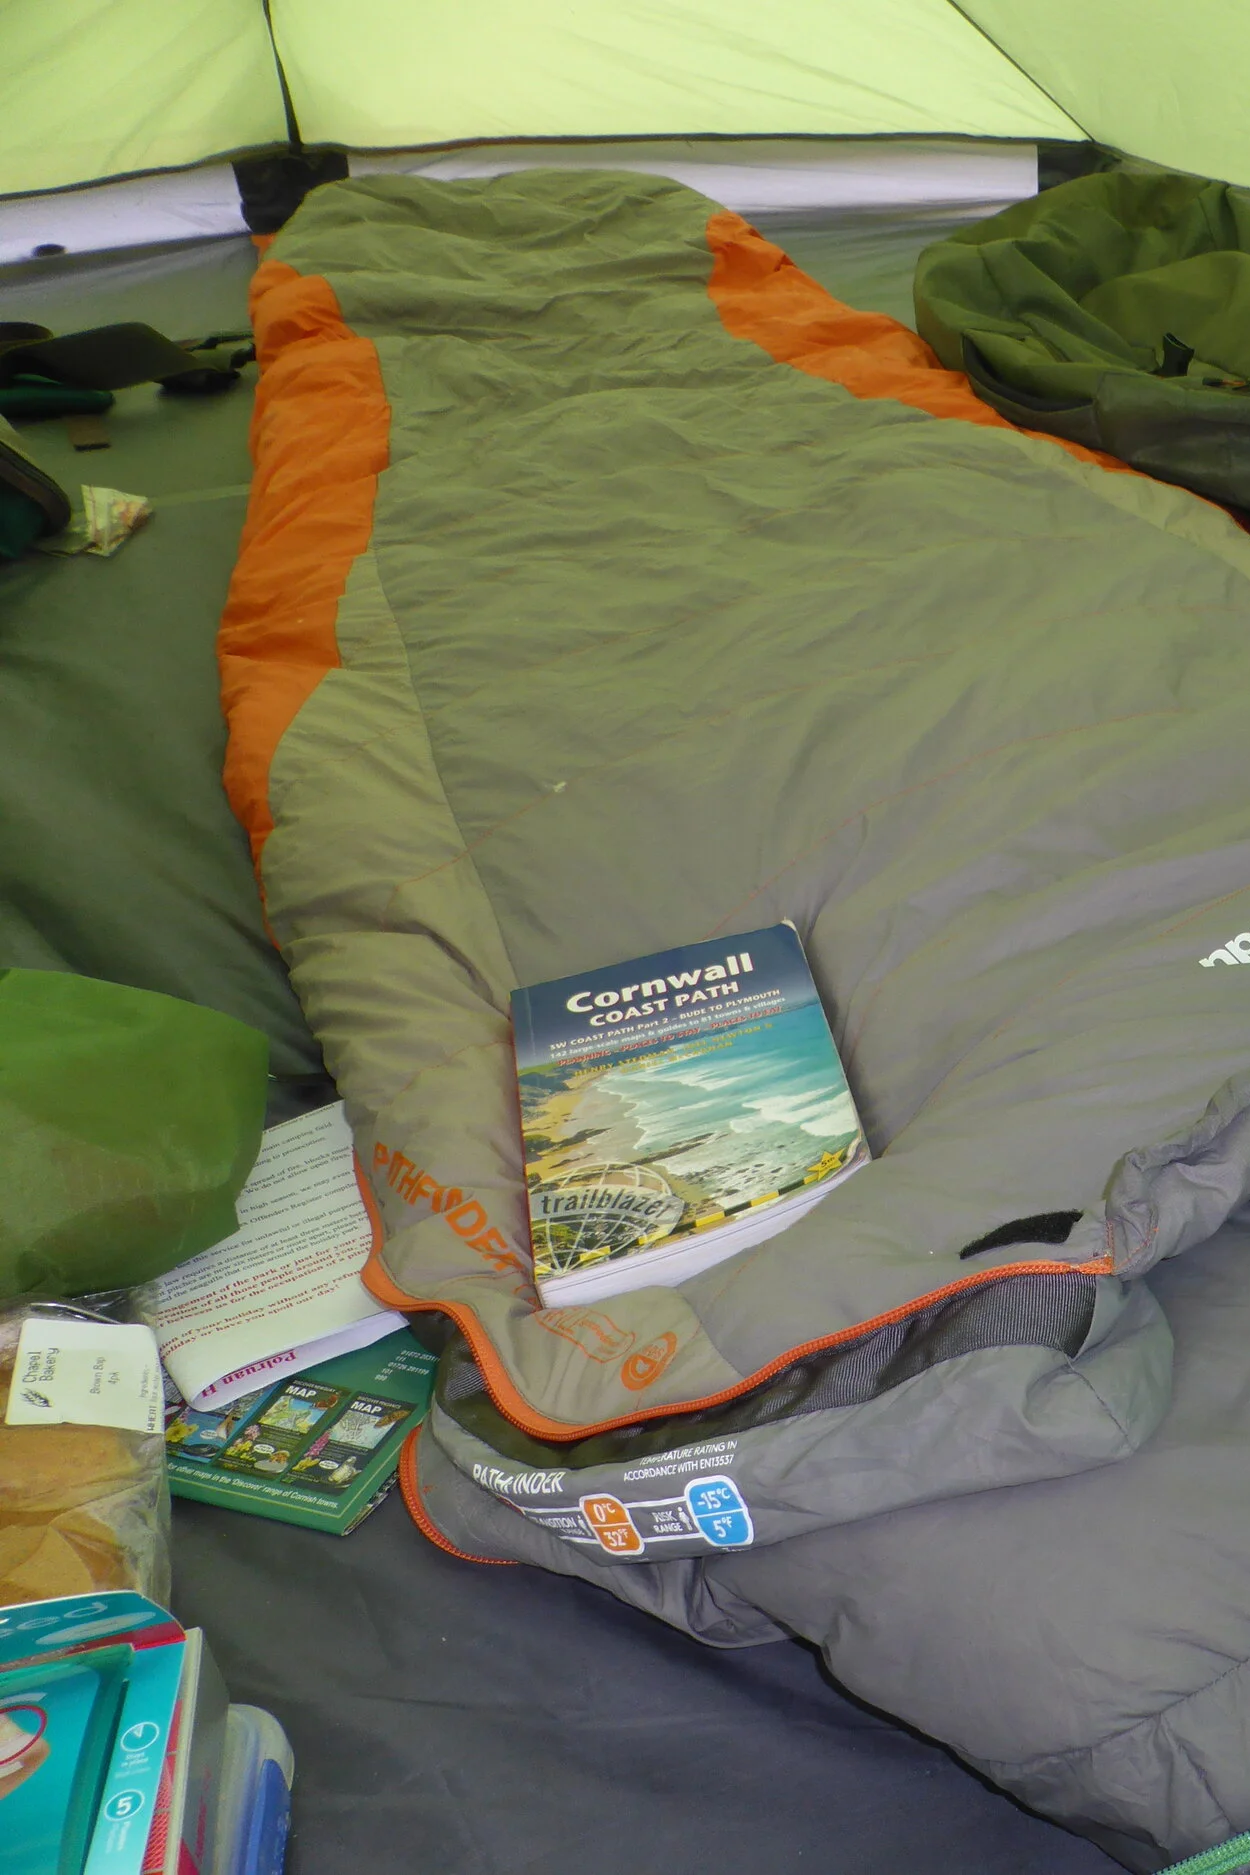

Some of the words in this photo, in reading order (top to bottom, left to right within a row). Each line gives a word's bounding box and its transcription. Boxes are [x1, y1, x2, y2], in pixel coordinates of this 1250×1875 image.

[563, 950, 755, 1016] Cornwall
[588, 997, 670, 1028] COAST
[673, 980, 740, 1007] PATH
[548, 1041, 567, 1051] SW
[569, 1032, 605, 1046] COAST
[606, 1025, 635, 1037] PATH
[636, 1019, 658, 1030] Part
[661, 1016, 669, 1024] 2
[678, 1007, 707, 1020] BUDE
[709, 1003, 724, 1012] TO
[724, 988, 781, 1008] PLYMOUTH
[540, 1188, 676, 1218] trailblazer
[22, 1351, 41, 1383] Chapel
[39, 1348, 60, 1382] Bakery
[221, 1350, 297, 1385] Polruan
[90, 1368, 104, 1395] Brown
[285, 1385, 317, 1399] MAP
[350, 1401, 382, 1415] MAP
[692, 1442, 726, 1456] RATING
[726, 1440, 738, 1450] IN
[472, 1463, 567, 1496] PATHFINDER
[623, 1460, 676, 1482] ACCORDANCE
[676, 1460, 699, 1474] WITH
[700, 1454, 735, 1469] EN13537
[193, 1468, 212, 1480] maps
[290, 1490, 318, 1505] Cornish
[652, 1510, 674, 1524] RISK
[653, 1522, 684, 1534] RANGE
[116, 1796, 133, 1817] 5
